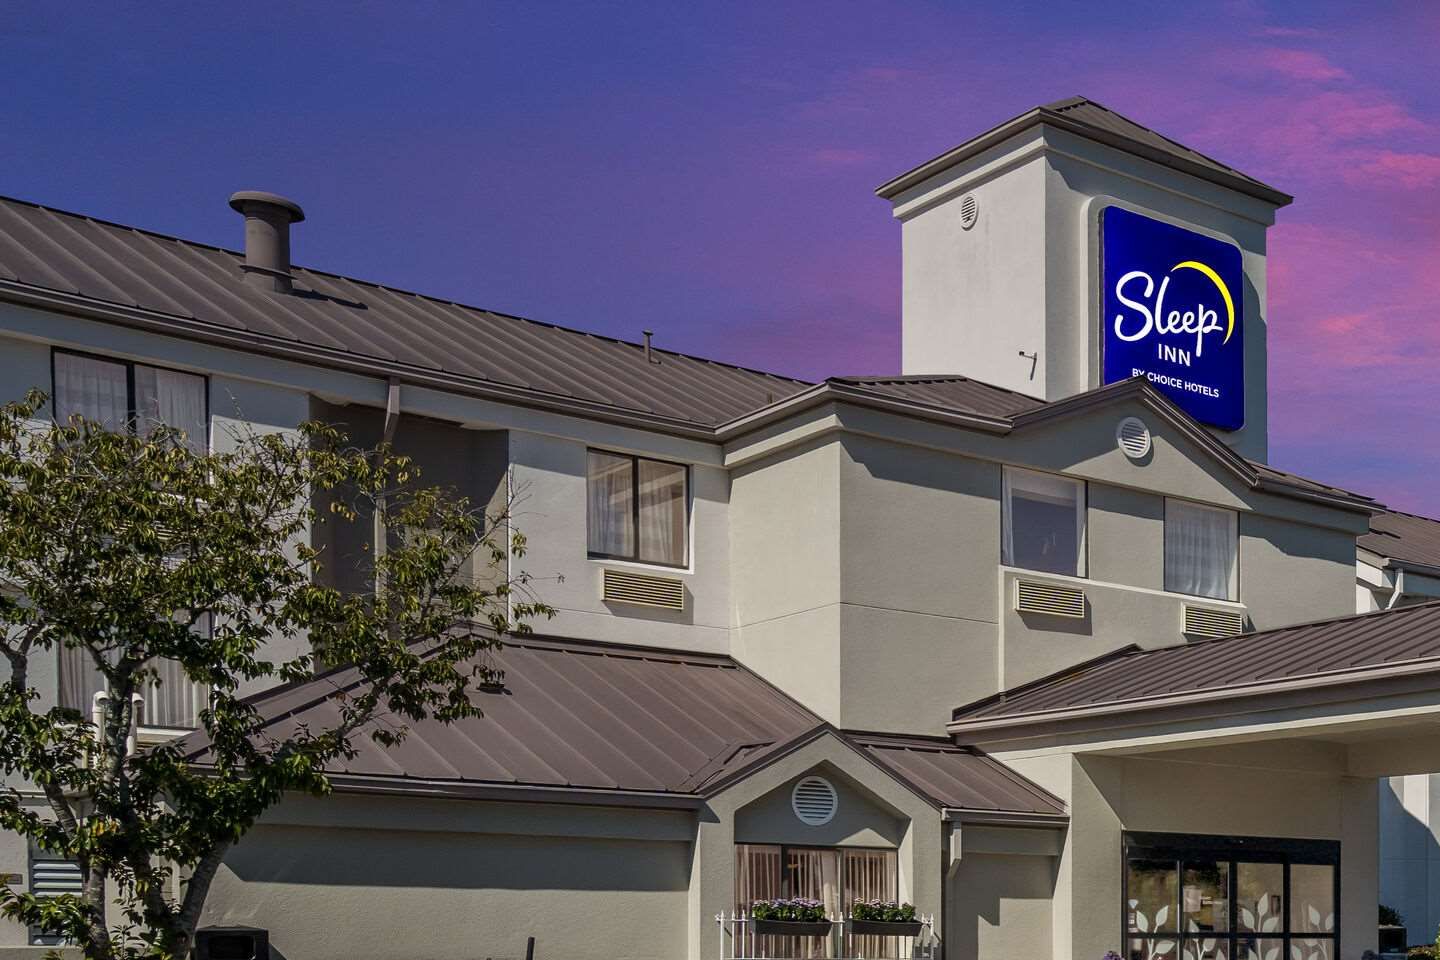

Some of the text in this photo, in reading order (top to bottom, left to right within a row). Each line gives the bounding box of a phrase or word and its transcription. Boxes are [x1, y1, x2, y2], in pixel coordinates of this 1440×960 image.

[1114, 271, 1224, 358] Sleep
[1158, 343, 1191, 367] INN
[1147, 372, 1183, 389] CHOICE
[1184, 381, 1219, 398] HOTELS
